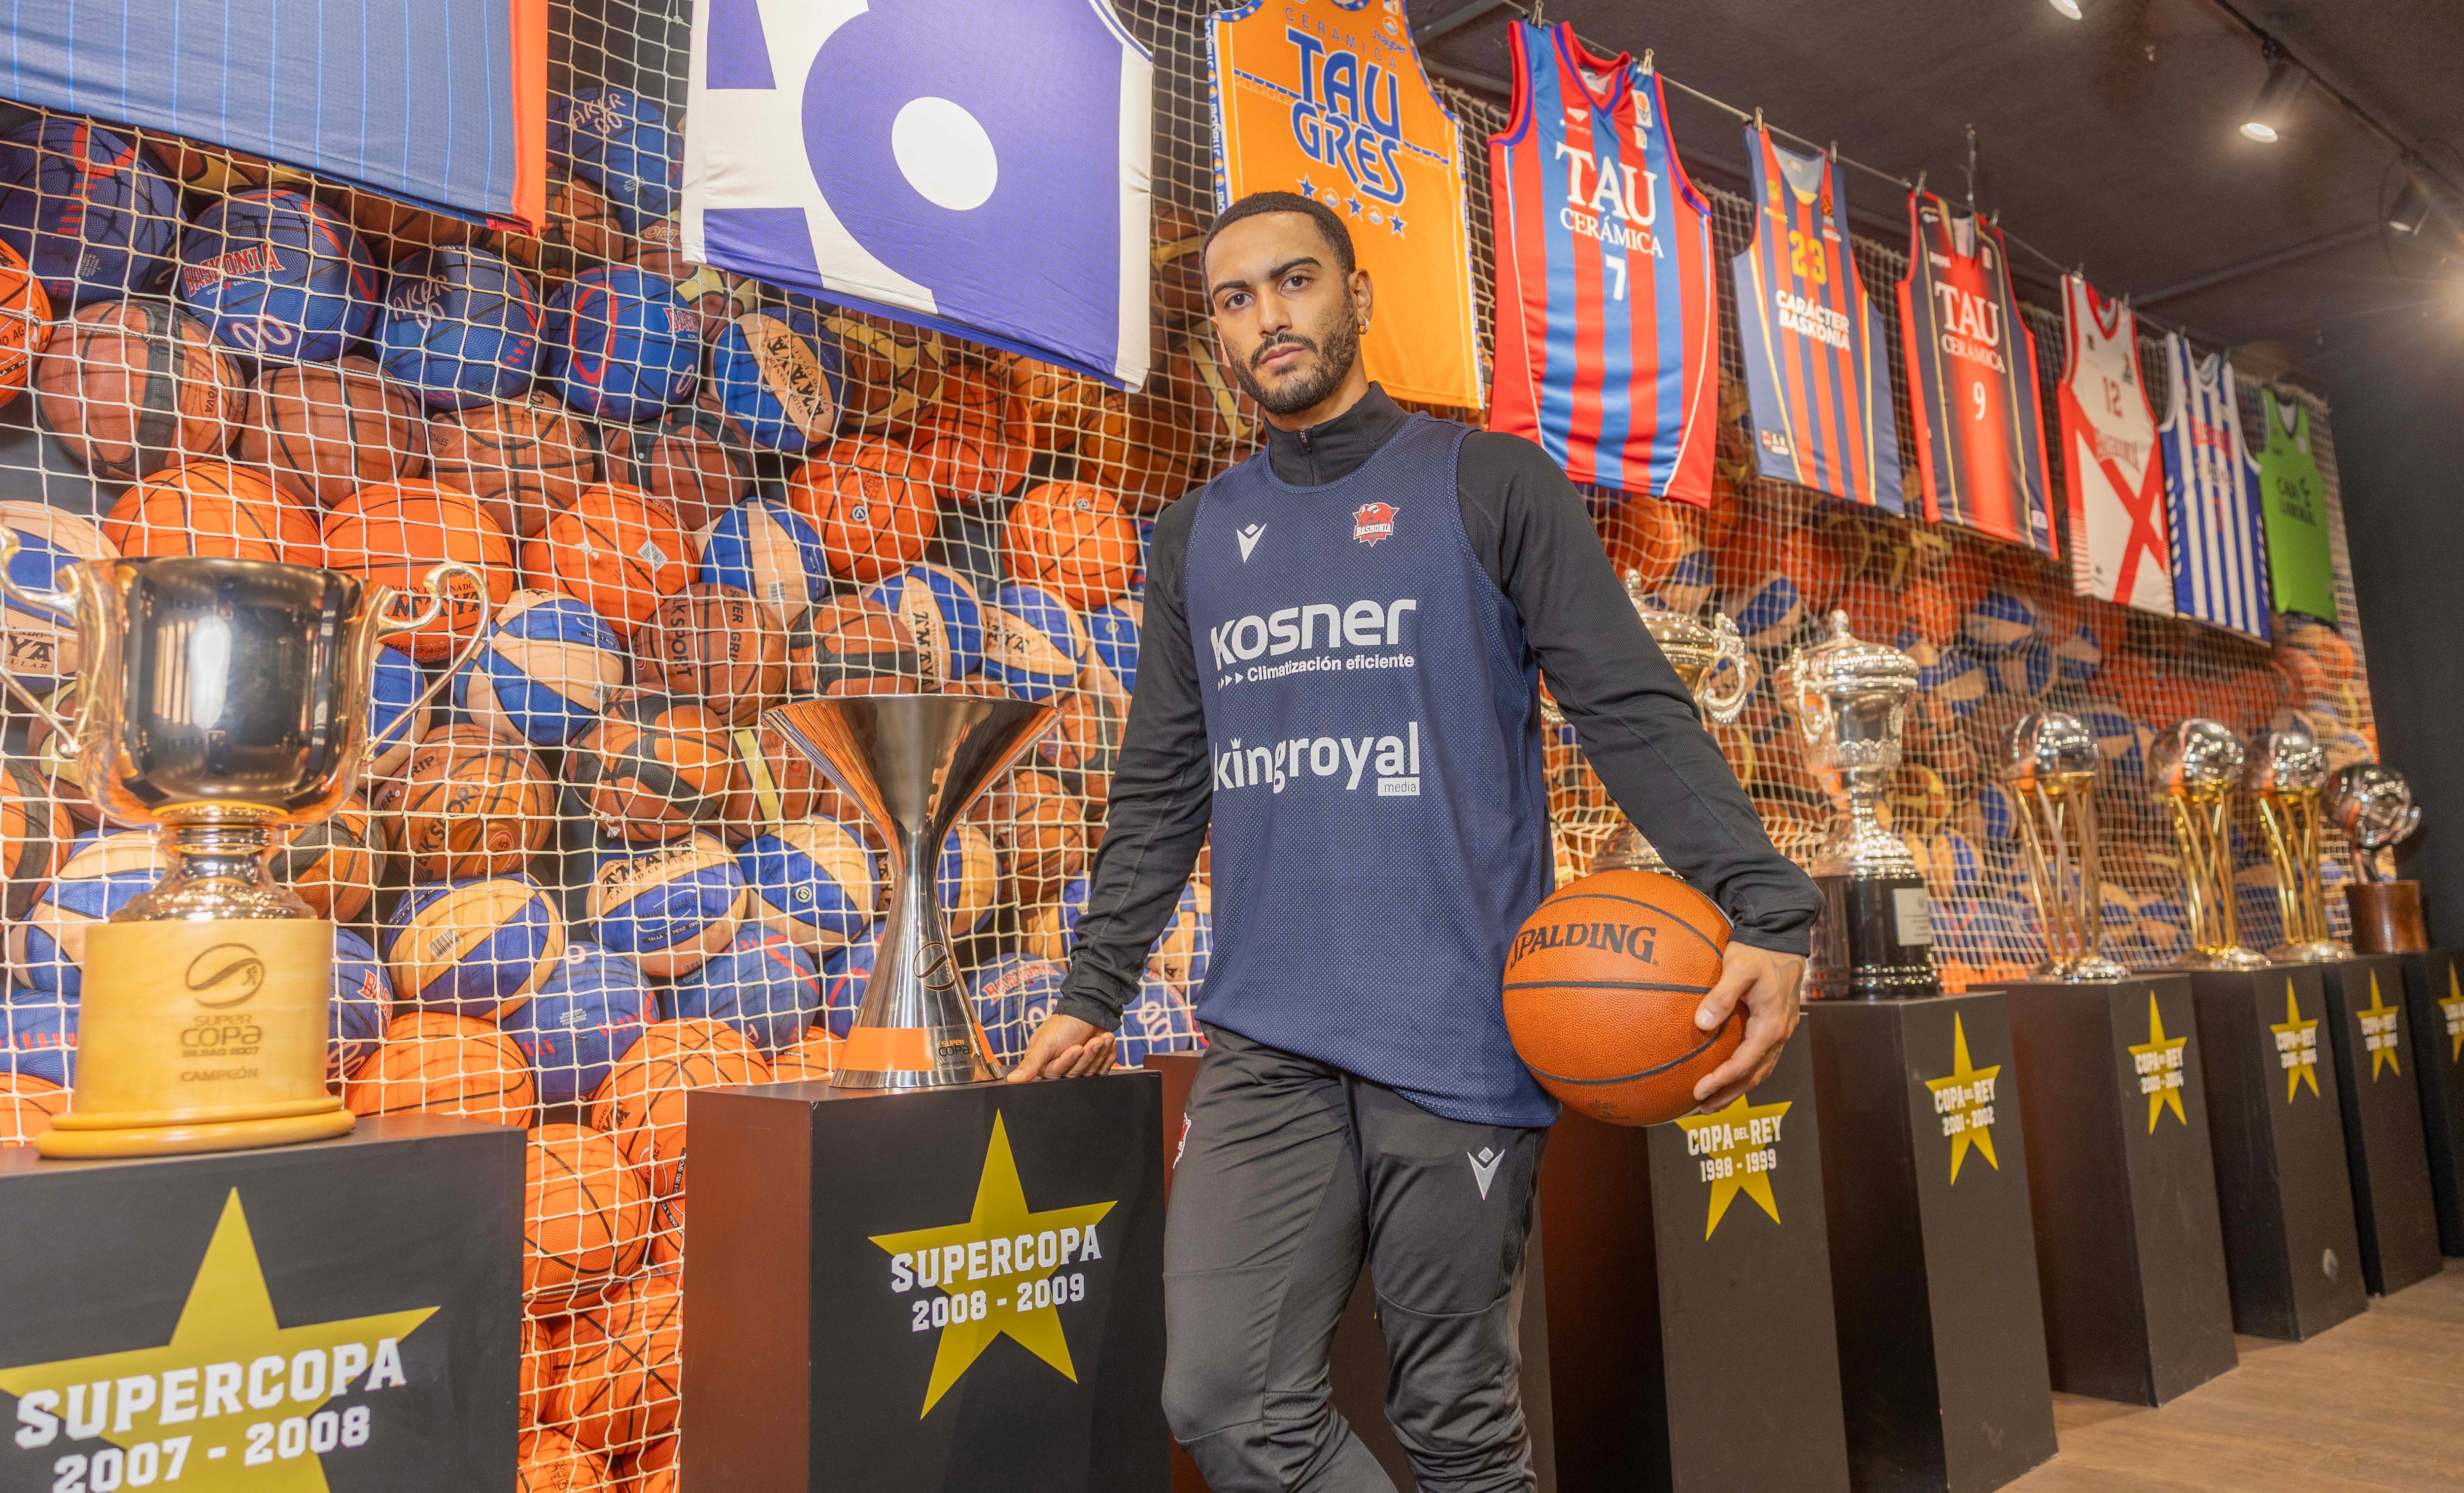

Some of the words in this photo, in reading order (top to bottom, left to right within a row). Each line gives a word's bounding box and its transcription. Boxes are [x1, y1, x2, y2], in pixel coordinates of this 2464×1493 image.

[1285, 24, 1403, 143] TAU
[1291, 98, 1405, 207] GRES
[1555, 141, 1657, 227] TAU
[1560, 207, 1665, 259] CERÁMICA
[1789, 230, 1827, 284] 23
[183, 244, 286, 297] BASKONIA
[1605, 255, 1626, 301] 7
[232, 313, 292, 353] 00
[1776, 290, 1850, 333] CARÁCTER
[1779, 307, 1851, 351] BASKONIA
[1935, 280, 1999, 347] TAU
[1941, 333, 2006, 374] CERÁMICA
[1973, 381, 1985, 420] 9
[1247, 656, 1341, 683] Climatización
[1346, 654, 1415, 670] eficiente
[1213, 722, 1420, 793] kingroyal
[1510, 923, 1657, 970] SPALDING
[1934, 1085, 1966, 1113] COPA
[1974, 1077, 1996, 1104] REY
[1687, 1124, 1734, 1156] COPA
[1734, 1124, 1749, 1141] DEL
[1750, 1115, 1783, 1145] REY
[1700, 1156, 1733, 1183] 1998
[1746, 1148, 1777, 1175] 1999
[891, 1224, 1102, 1293] SUPERCOPA
[912, 1290, 987, 1332] 2008
[1017, 1273, 1085, 1313] 2009
[15, 1337, 407, 1450] SUPERCOPA
[52, 1435, 192, 1493] 2007
[244, 1405, 371, 1466] 2008
